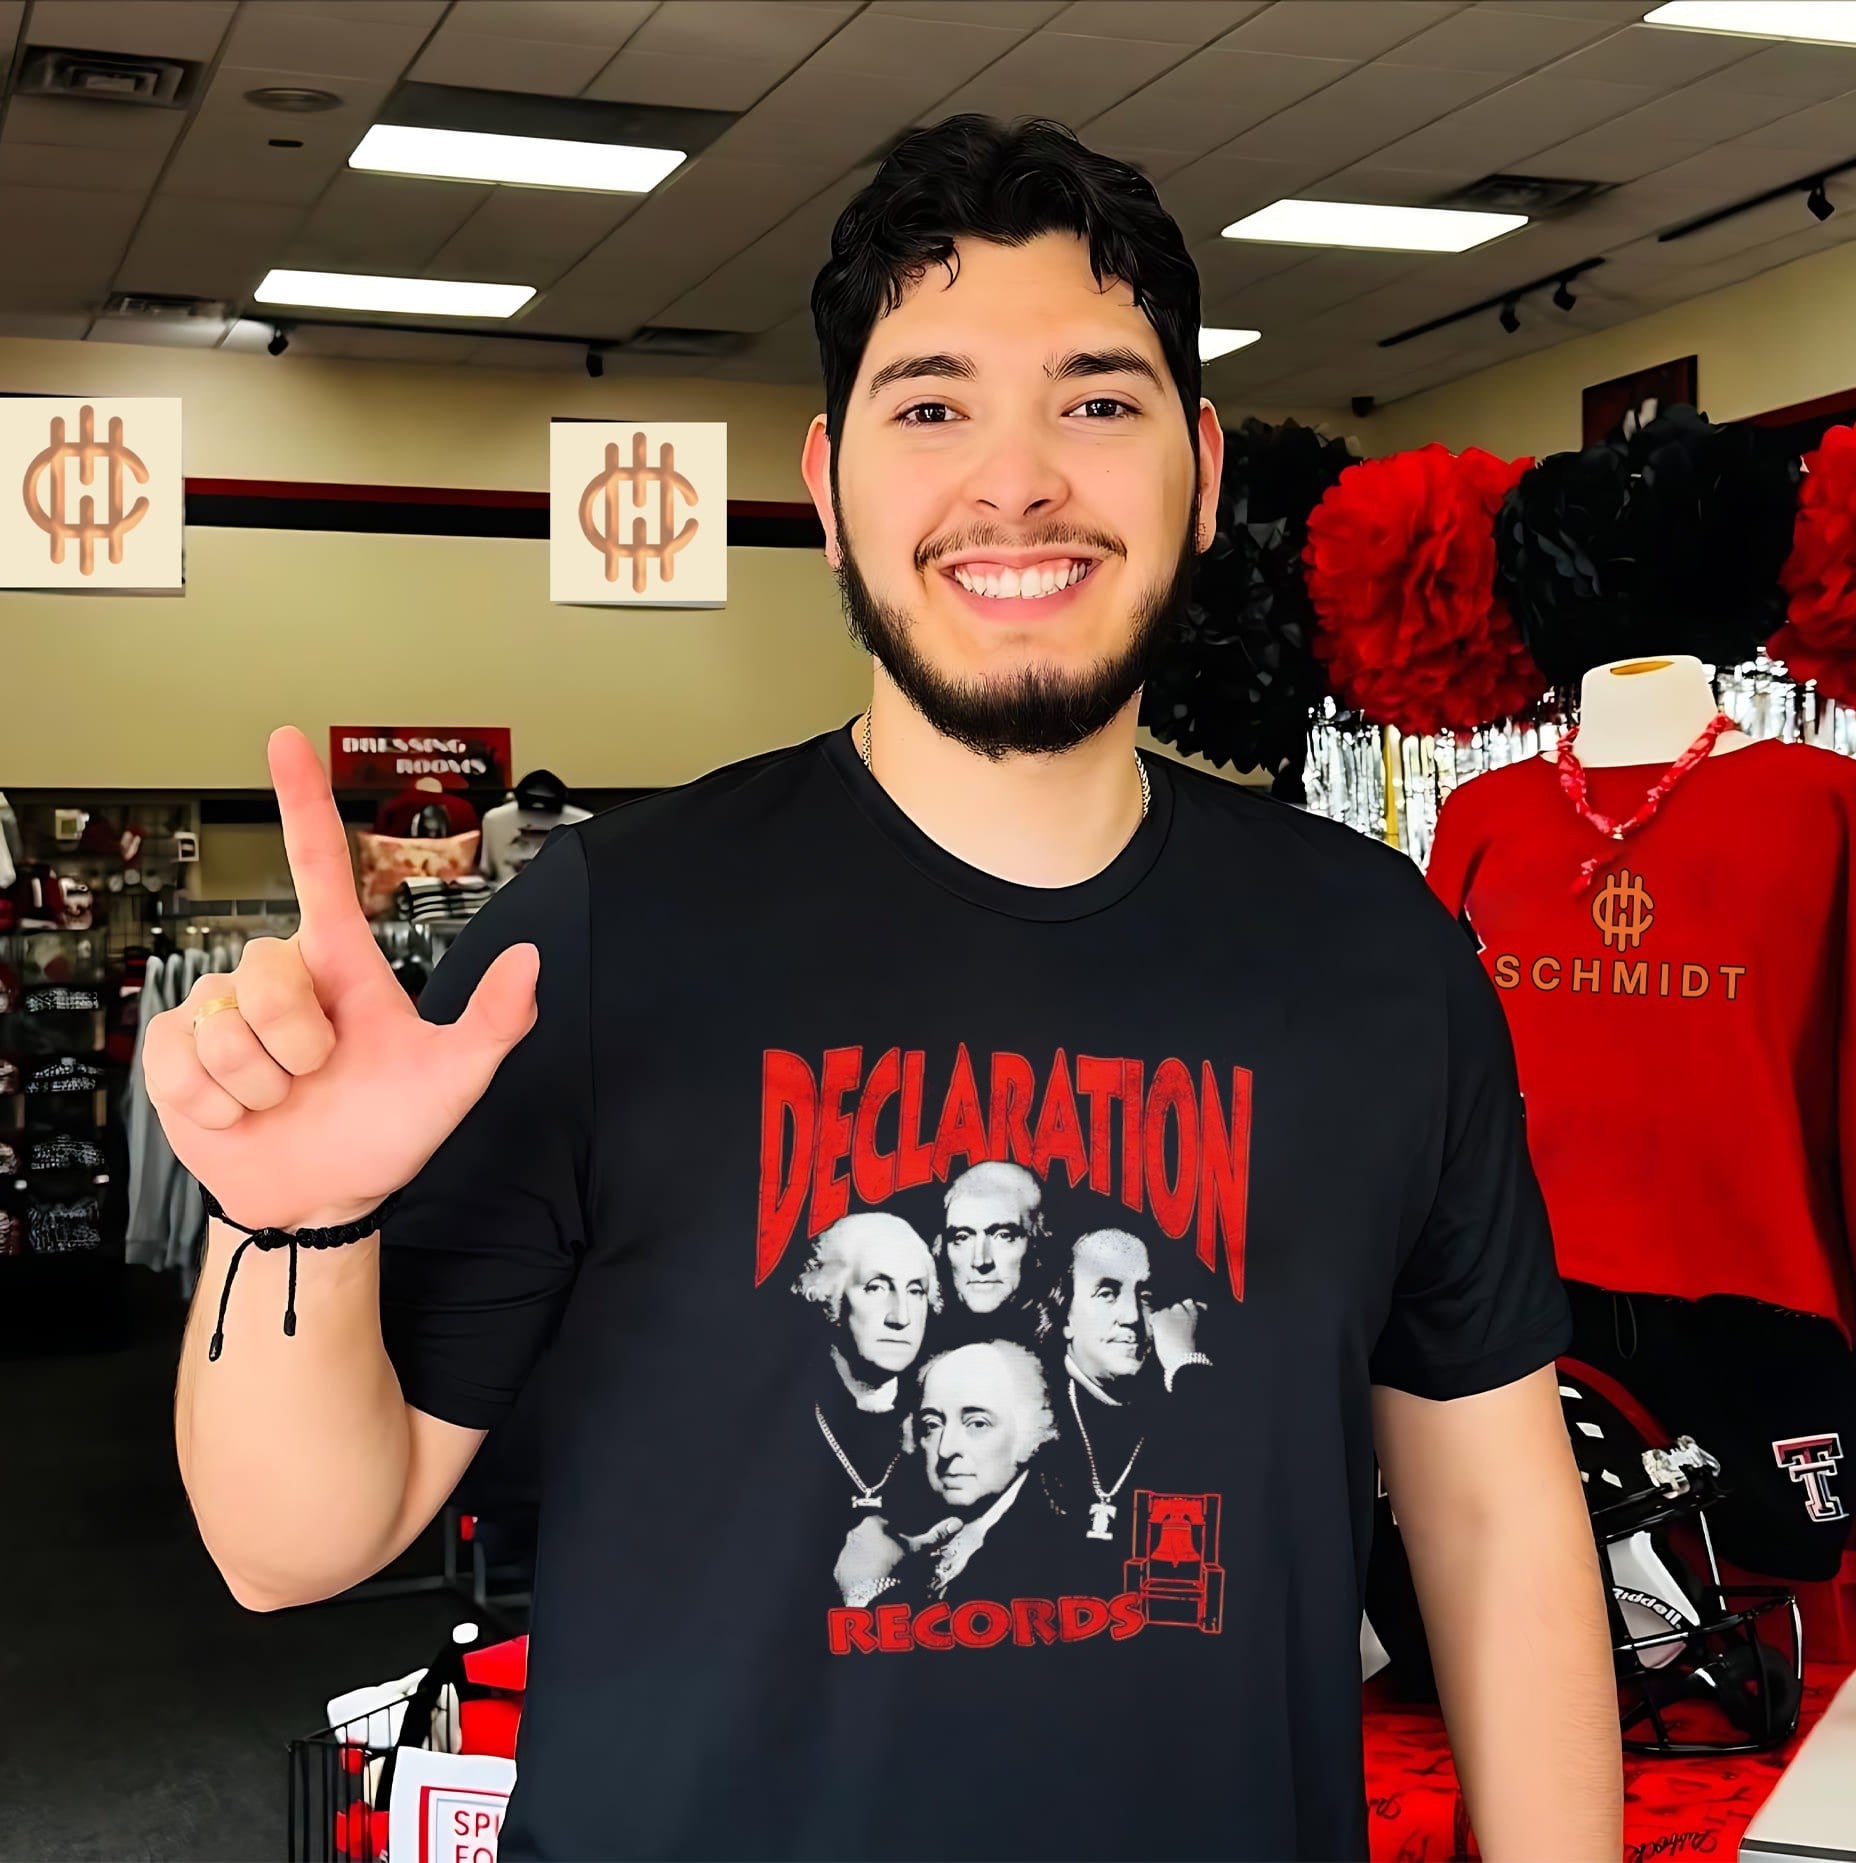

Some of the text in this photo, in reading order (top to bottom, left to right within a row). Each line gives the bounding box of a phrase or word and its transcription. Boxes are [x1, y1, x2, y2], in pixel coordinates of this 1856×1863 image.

[342, 737, 467, 754] DRESSING
[396, 758, 487, 775] ROOMS
[1494, 954, 1747, 1001] SCHMIDT
[755, 1042, 1253, 1303] DECLARATION
[827, 1592, 1146, 1656] RECORDS
